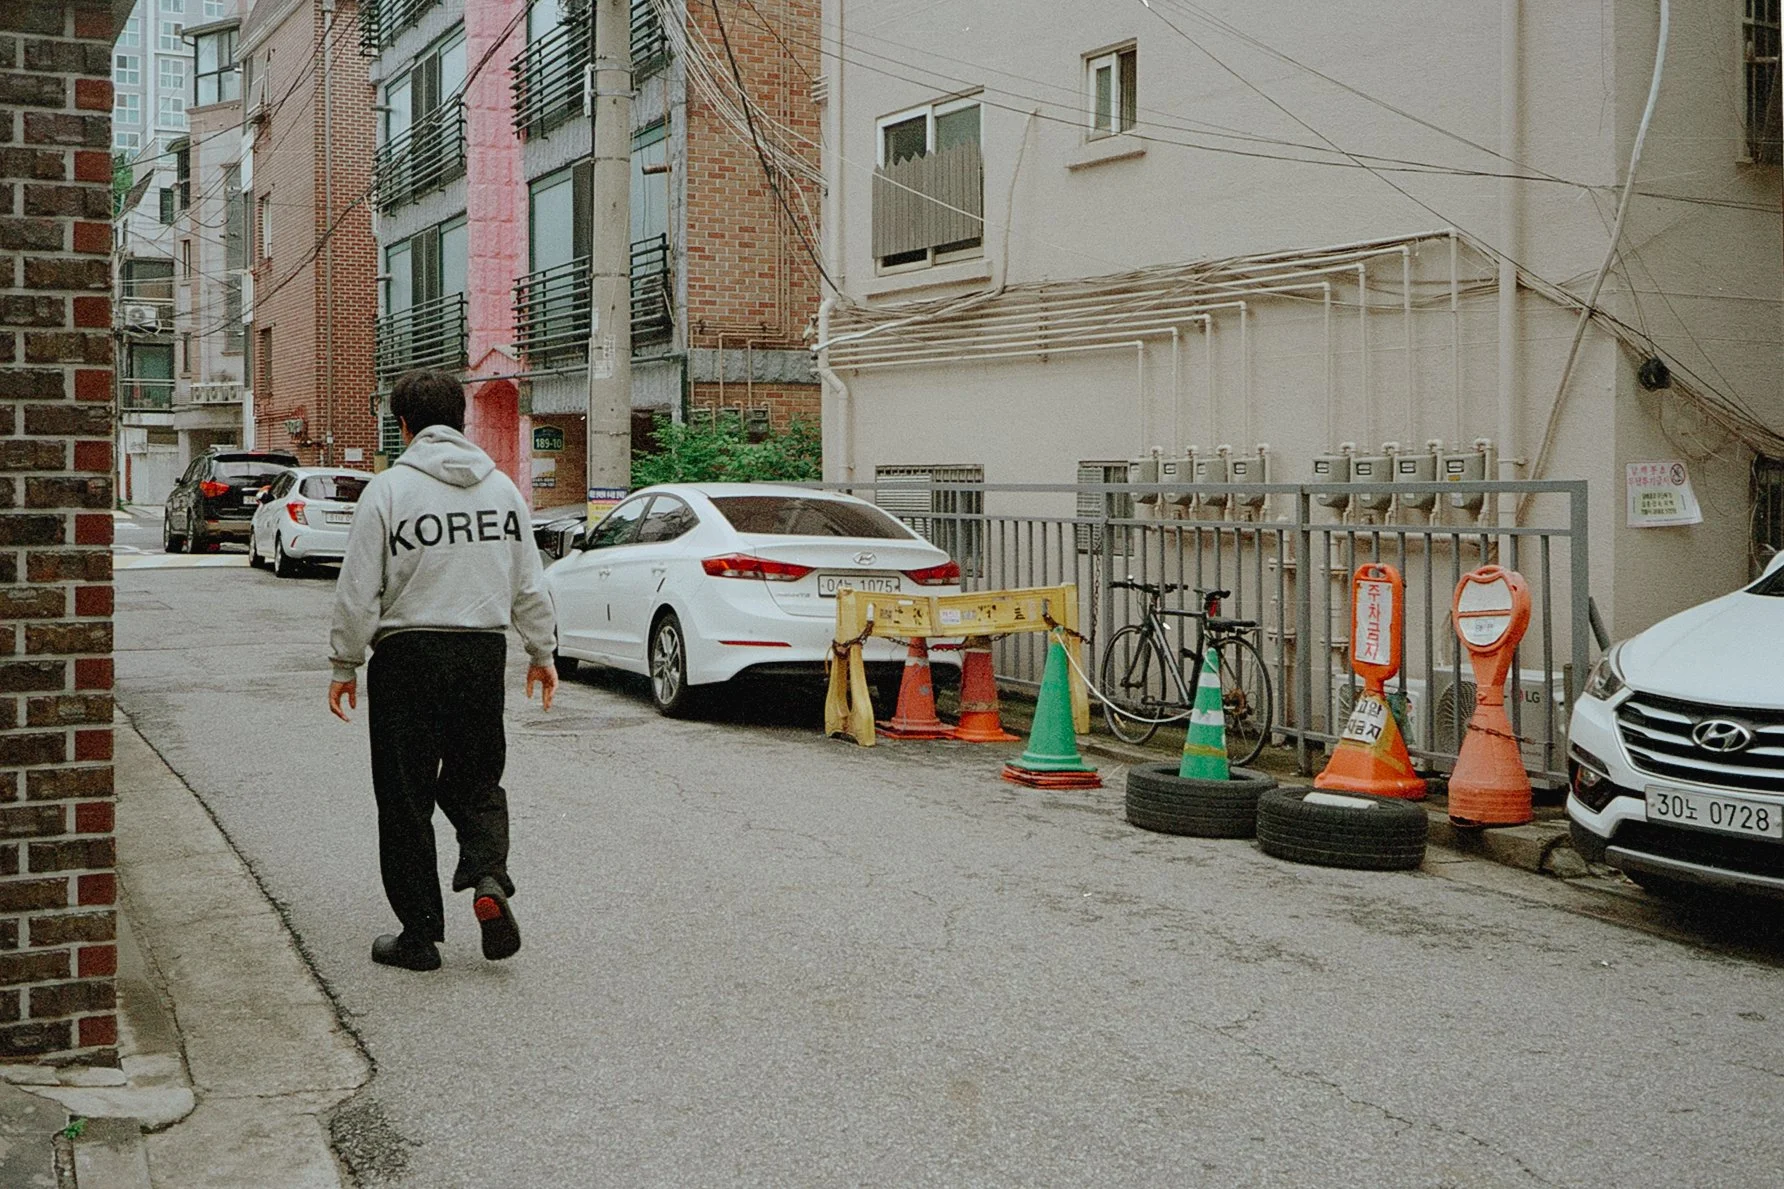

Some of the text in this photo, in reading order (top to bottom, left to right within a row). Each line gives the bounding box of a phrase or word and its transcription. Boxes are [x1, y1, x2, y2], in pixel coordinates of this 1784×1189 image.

[536, 438, 562, 449] 189-10
[389, 510, 522, 557] KOREA
[860, 579, 893, 593] 1075
[1364, 584, 1381, 660] 주차금지
[1525, 691, 1540, 704] LG
[1657, 793, 1770, 832] 30노 0728
